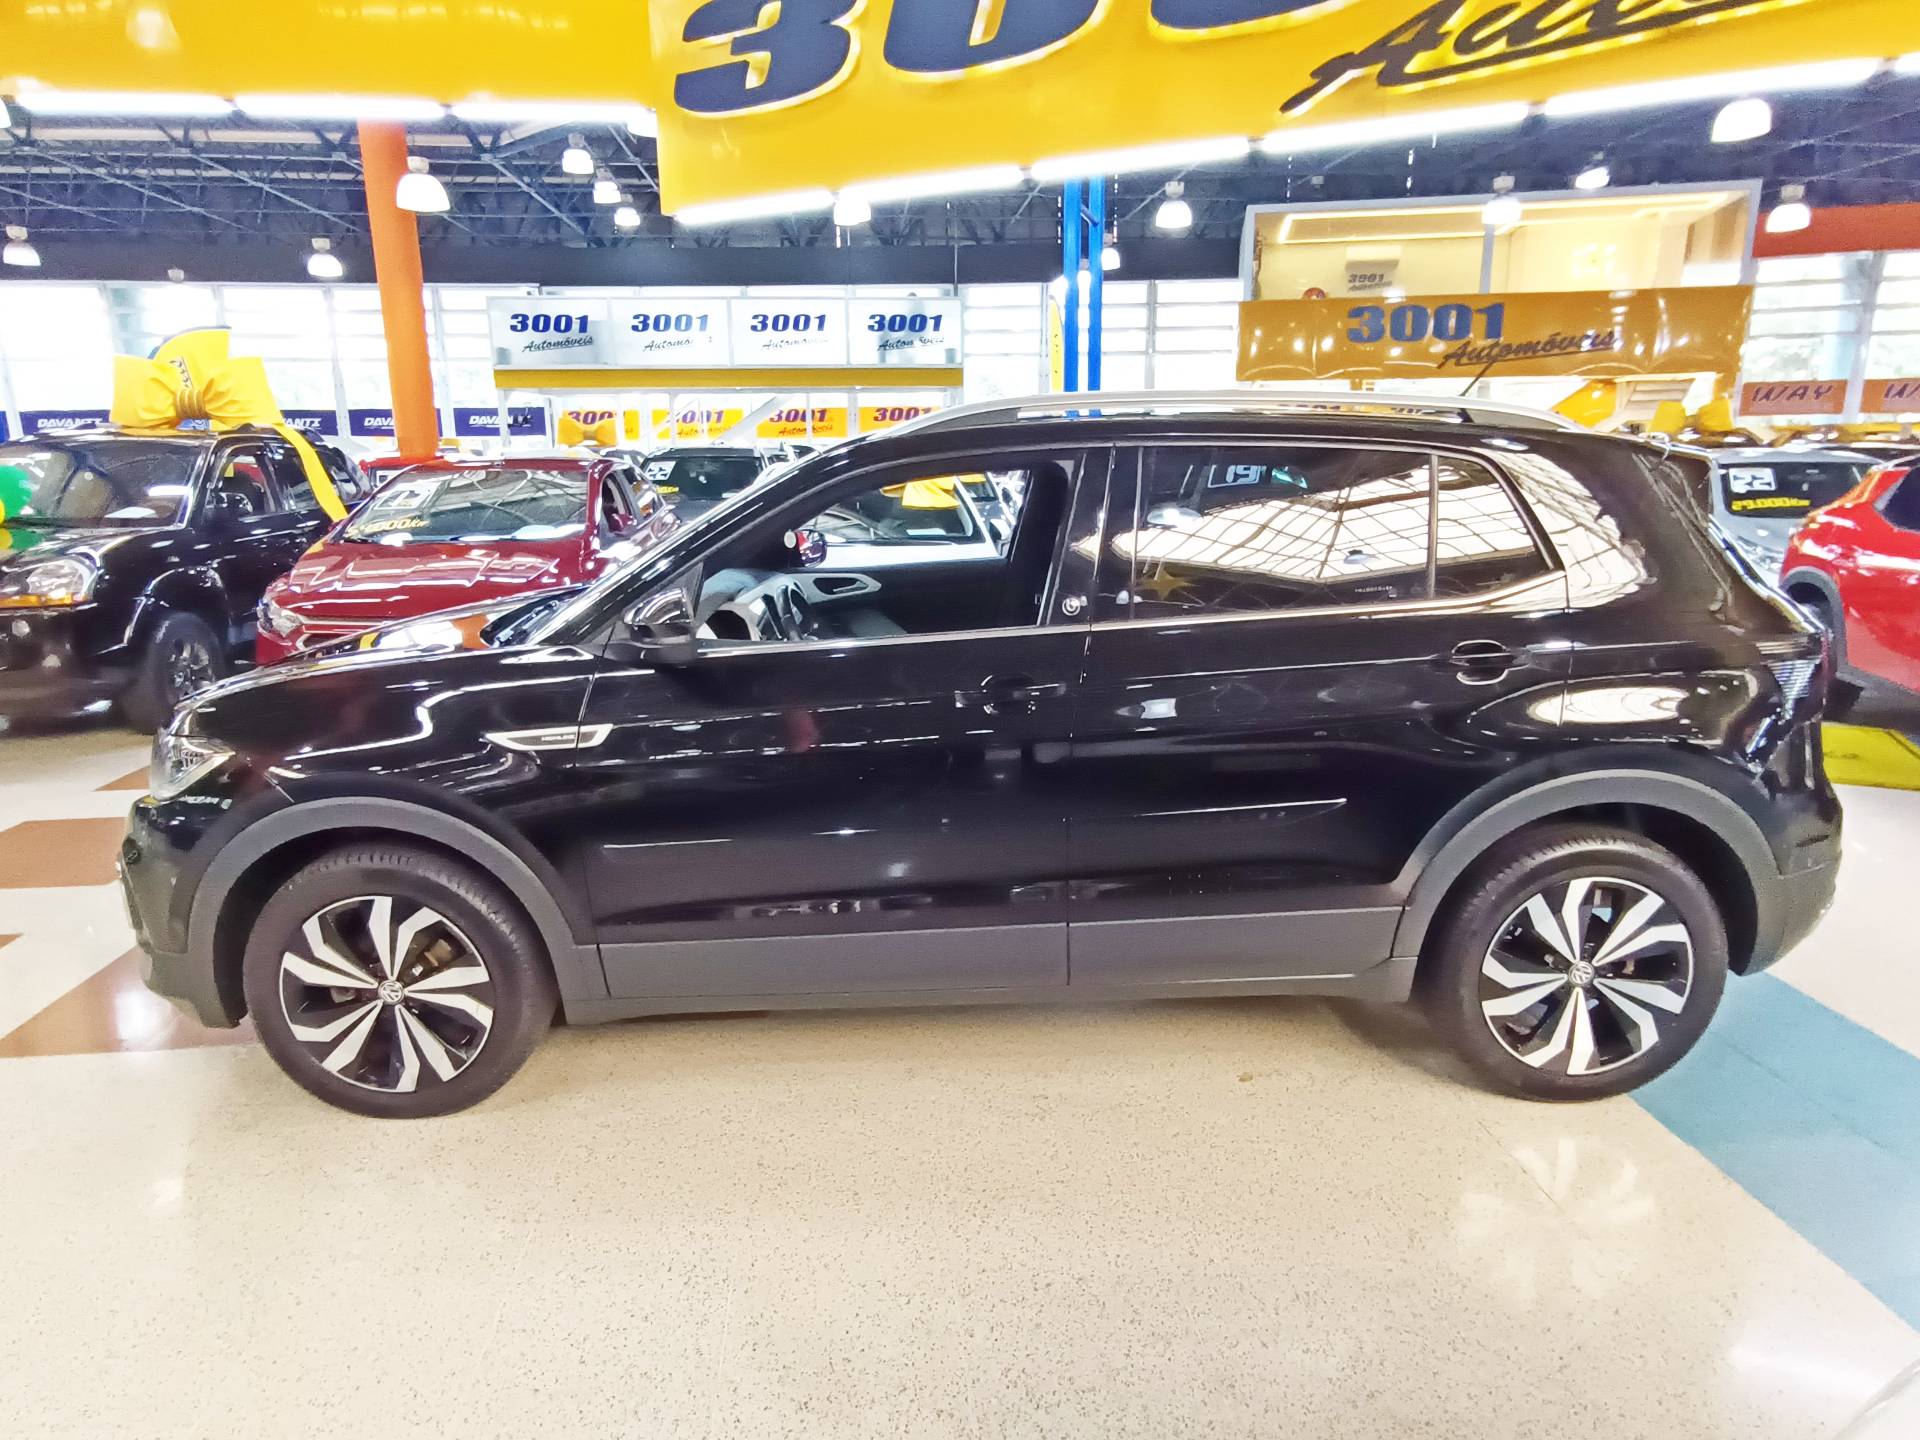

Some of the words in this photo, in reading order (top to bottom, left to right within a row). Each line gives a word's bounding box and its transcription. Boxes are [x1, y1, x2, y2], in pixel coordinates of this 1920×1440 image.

[673, 0, 1325, 113] 30
[509, 313, 589, 333] 3001
[631, 313, 709, 332] 3001
[750, 313, 827, 332] 3001
[867, 313, 943, 332] 3001
[1346, 302, 1505, 344] 3001
